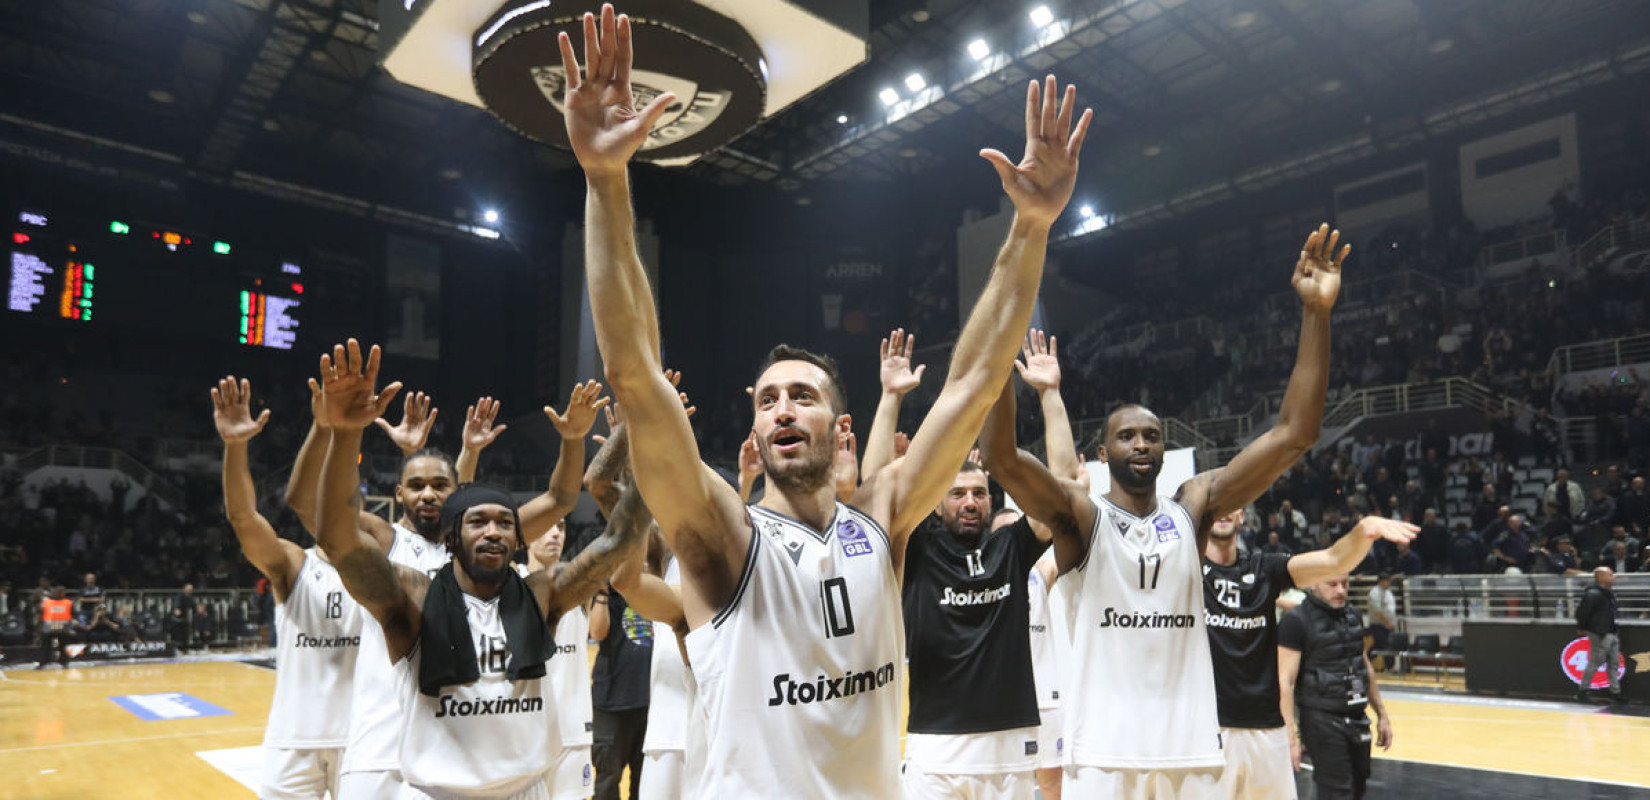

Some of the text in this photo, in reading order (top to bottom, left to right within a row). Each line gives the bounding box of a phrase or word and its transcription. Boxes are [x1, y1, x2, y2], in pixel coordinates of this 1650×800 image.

[846, 543, 872, 556] GBL
[966, 549, 986, 577] 13
[1138, 553, 1160, 589] 17
[326, 592, 342, 619] 18
[1214, 579, 1241, 608] 25
[820, 577, 855, 639] 10
[1100, 607, 1196, 629] Stoiximan
[90, 643, 127, 654] ARAL
[295, 633, 361, 648] Stoixima
[480, 633, 507, 673] 16
[768, 662, 895, 707] Stoiximan
[435, 695, 544, 718] Stoiximan
